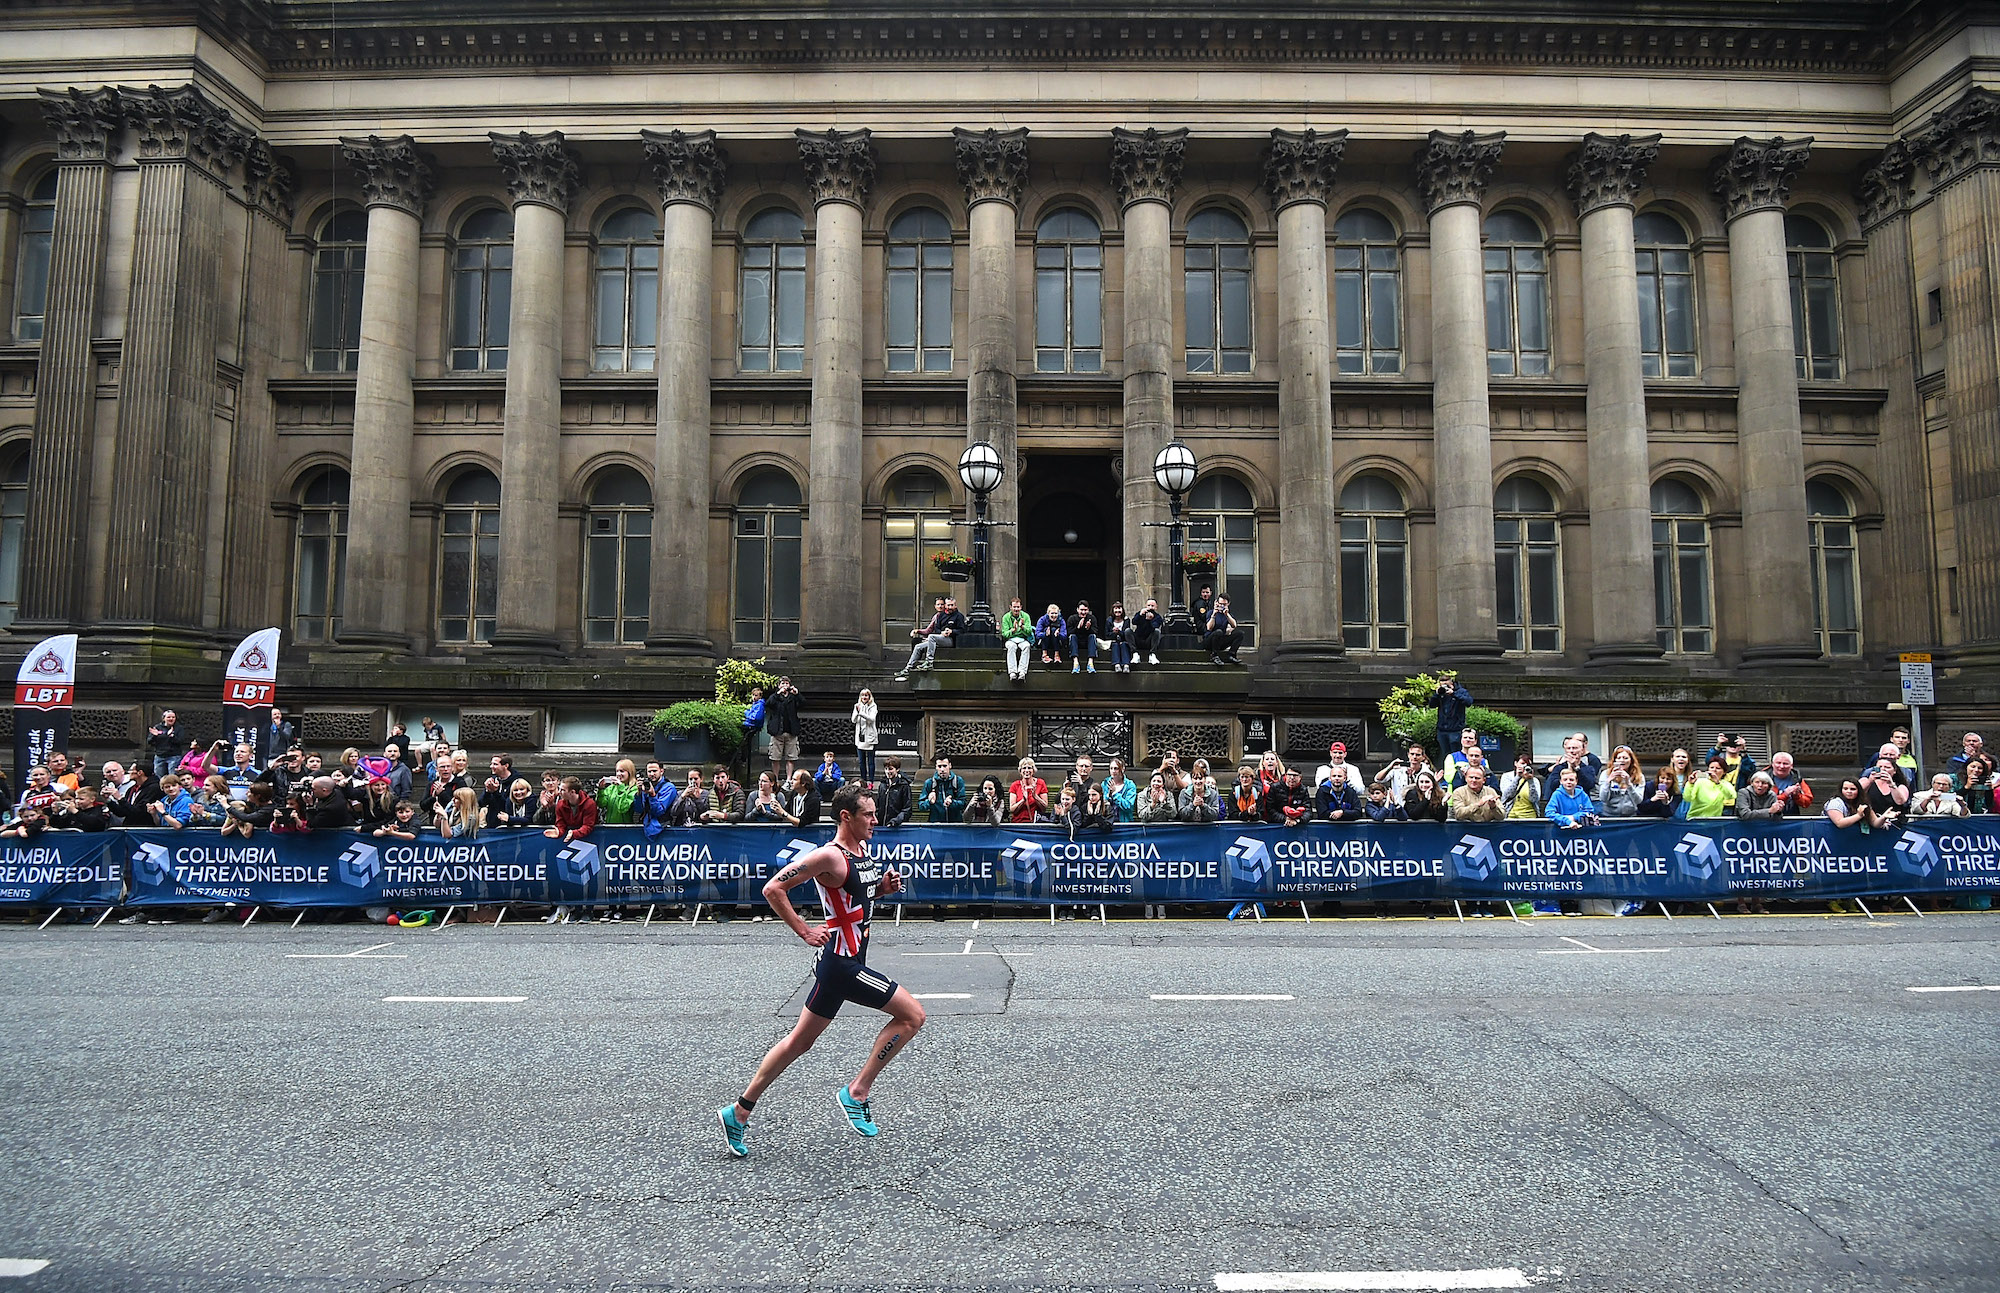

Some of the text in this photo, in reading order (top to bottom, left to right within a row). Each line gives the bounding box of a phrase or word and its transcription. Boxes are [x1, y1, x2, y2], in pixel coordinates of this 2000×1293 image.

[24, 688, 68, 703] LBT
[232, 684, 270, 700] LBT
[605, 844, 712, 861] COLUMBIA
[867, 844, 935, 860] UMBIA
[1051, 843, 1160, 859] COLUMBIA
[1274, 841, 1385, 858] COLUMBIA
[1500, 839, 1609, 856] COLUMBIA
[1723, 837, 1831, 854] COLUMBIA
[175, 848, 278, 864] COLUMBIA
[385, 846, 490, 863] COLUMBIA
[1052, 862, 1217, 878] THREADNEEDLE
[1276, 860, 1444, 877] THREADNEEDLE
[1500, 858, 1667, 875] THREADNEEDLE
[1725, 856, 1888, 873] THREADNEEDLE
[1942, 855, 2000, 871] THRE
[175, 866, 328, 882] THREADNEEDLE
[384, 864, 546, 882] THREADNEEDLE
[605, 864, 767, 880] THREADNEEDLE
[778, 869, 798, 882] 33
[605, 885, 685, 894] INVESTMENTS
[1052, 884, 1132, 893] INVESTMENTS
[1278, 882, 1357, 891] INVESTMENTS
[1504, 881, 1583, 890] INVESTMENTS
[1729, 879, 1805, 888] INVESTMENTS
[175, 887, 250, 897] INVESTMENTS
[383, 886, 462, 898] INVESTMENTS
[878, 1042, 893, 1060] 33
